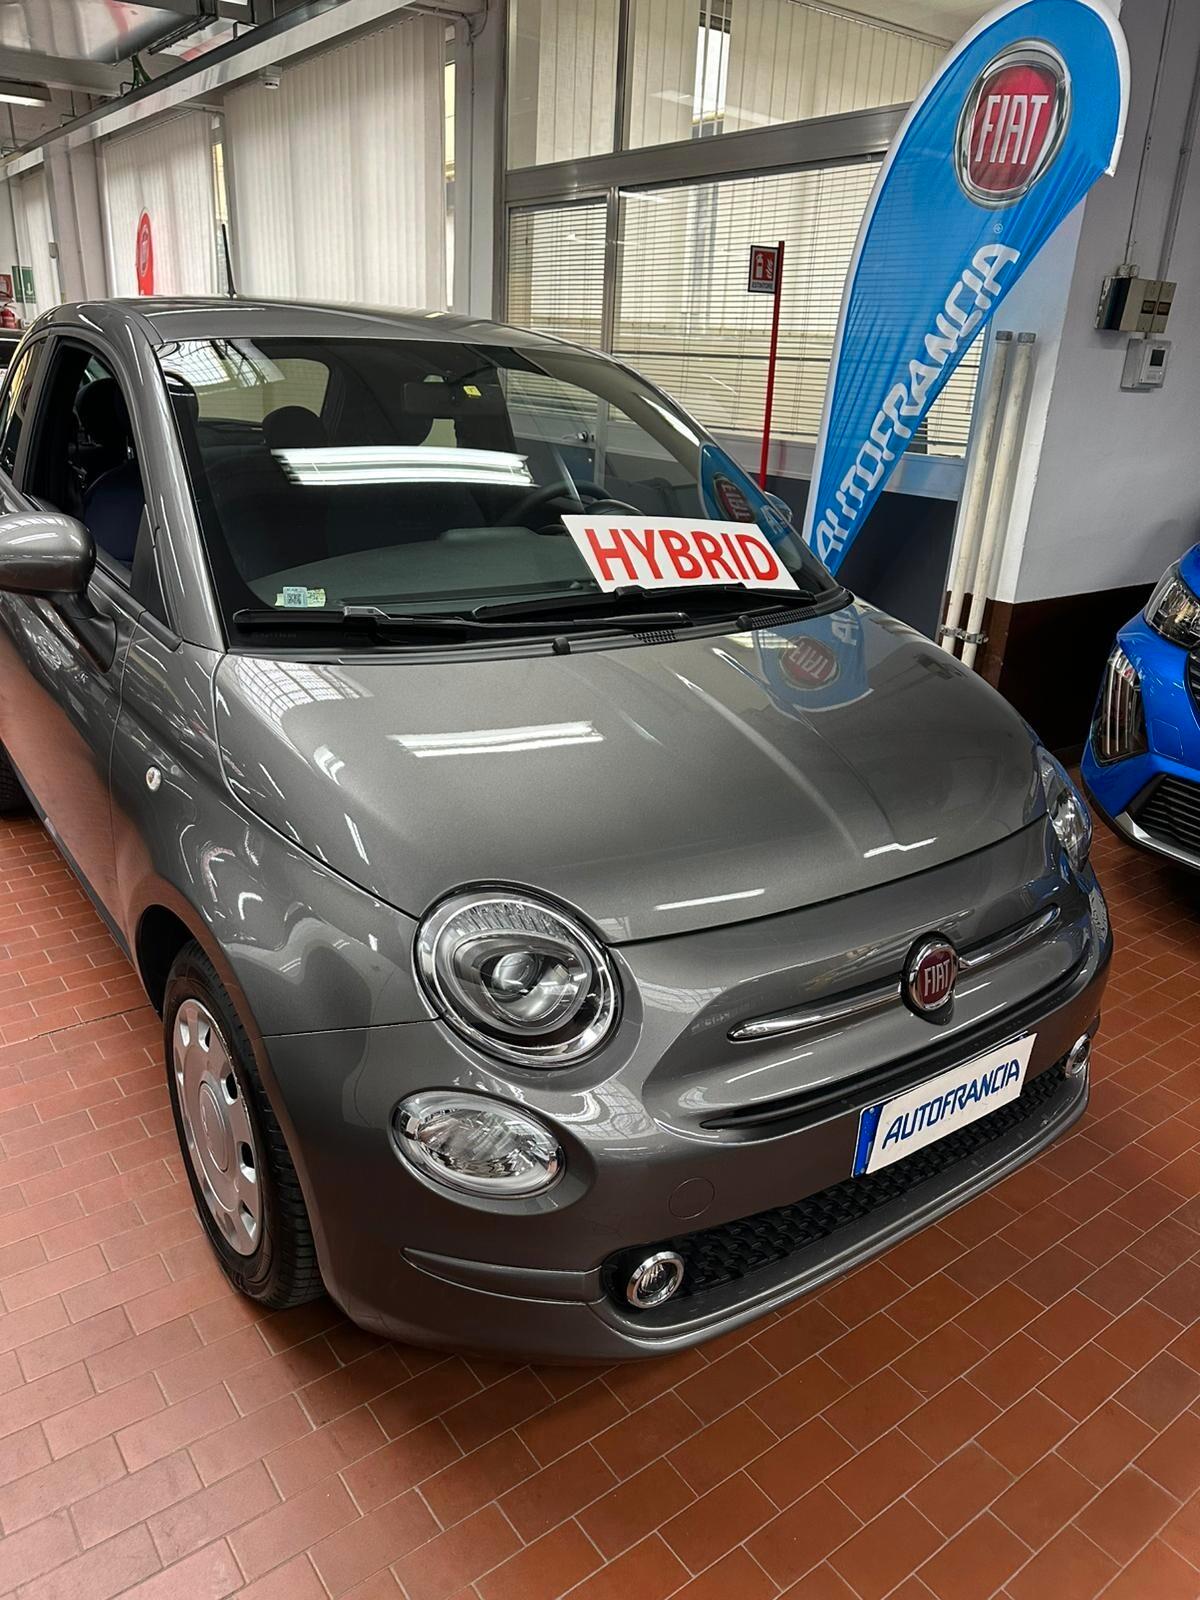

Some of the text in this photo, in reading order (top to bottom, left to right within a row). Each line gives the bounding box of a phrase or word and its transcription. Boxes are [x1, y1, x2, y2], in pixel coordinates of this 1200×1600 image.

[974, 94, 1049, 165] FIAT
[815, 243, 1021, 568] AUTOFRANCIA
[584, 528, 780, 581] HYBRID
[923, 959, 951, 997] FIAT
[881, 1058, 1021, 1150] AUTOFRANCIA
